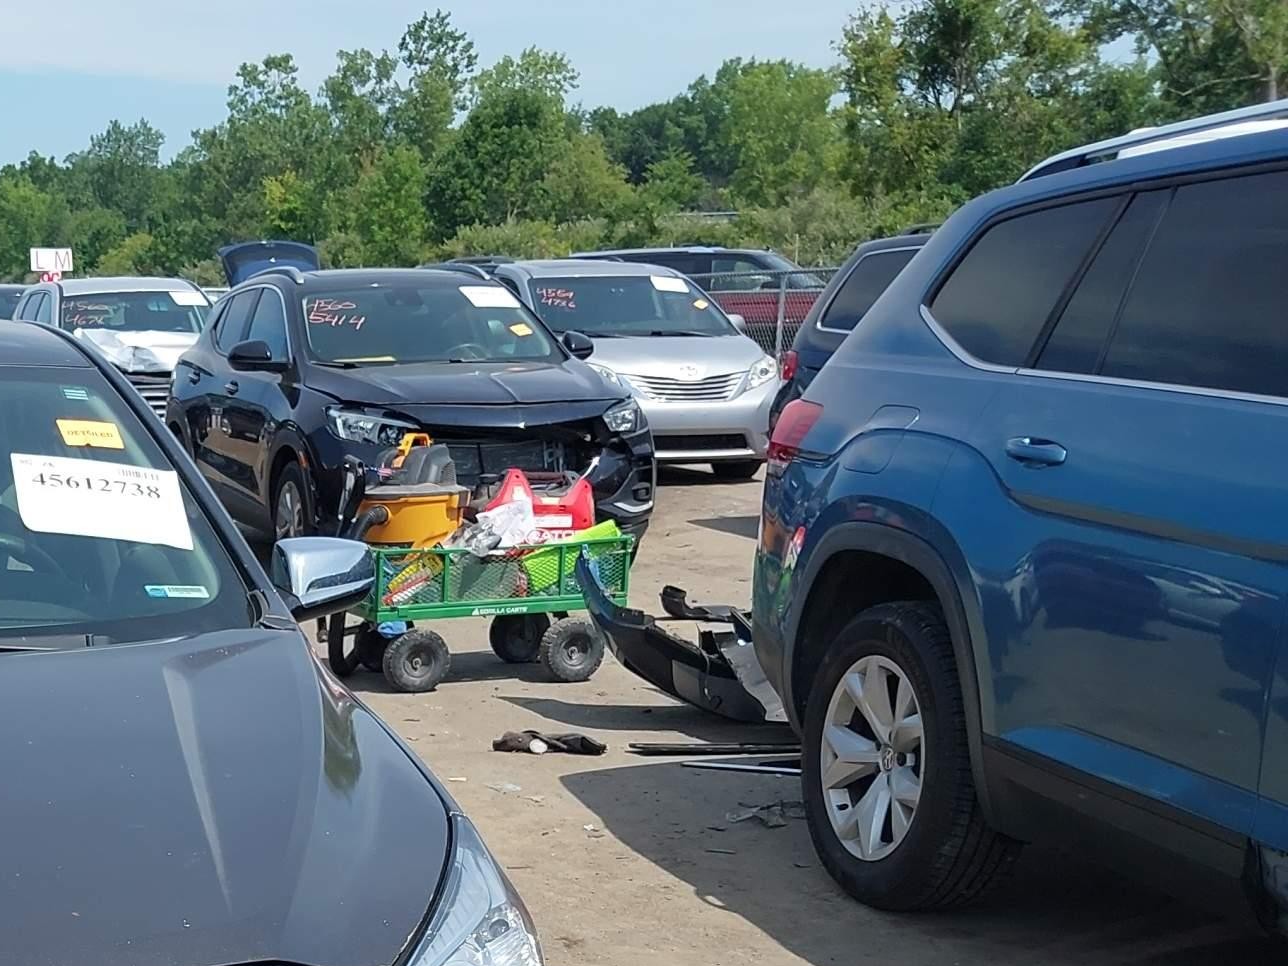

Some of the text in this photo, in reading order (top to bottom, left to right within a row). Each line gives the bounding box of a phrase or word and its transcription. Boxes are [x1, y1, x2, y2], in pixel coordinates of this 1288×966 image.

[54, 250, 71, 270] M
[309, 311, 366, 331] 5414
[31, 471, 161, 500] 45612738
